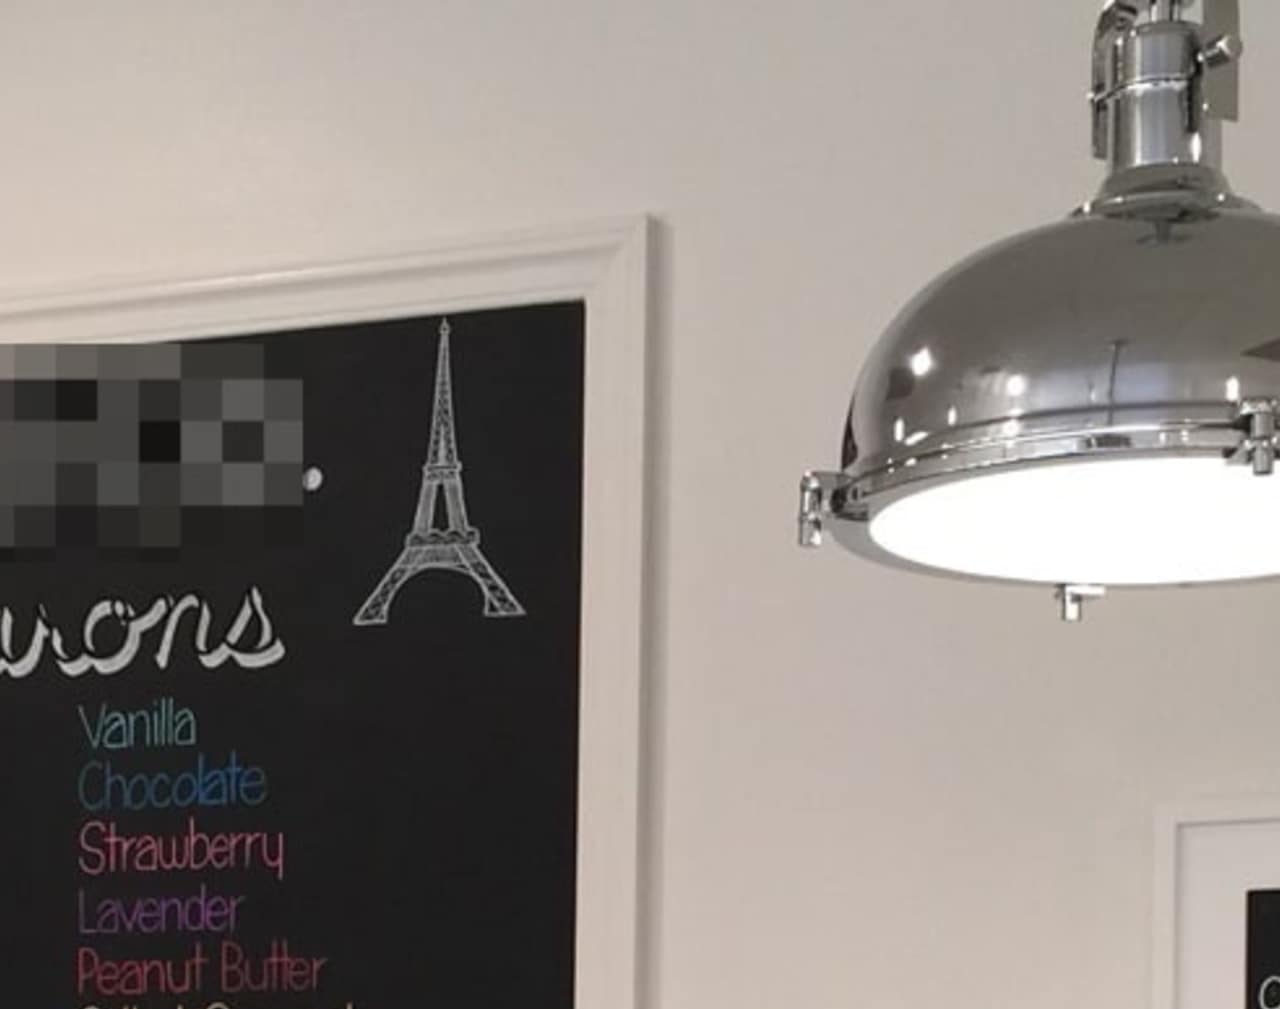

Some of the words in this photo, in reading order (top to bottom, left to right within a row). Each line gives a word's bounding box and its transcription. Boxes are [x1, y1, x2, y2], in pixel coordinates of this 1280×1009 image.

[78, 696, 197, 750] Vanilla
[79, 751, 267, 809] Chocolate
[78, 817, 284, 880] Strawberry
[78, 884, 245, 935] Lavender
[78, 947, 208, 996] Peanut
[221, 938, 327, 993] Butter
